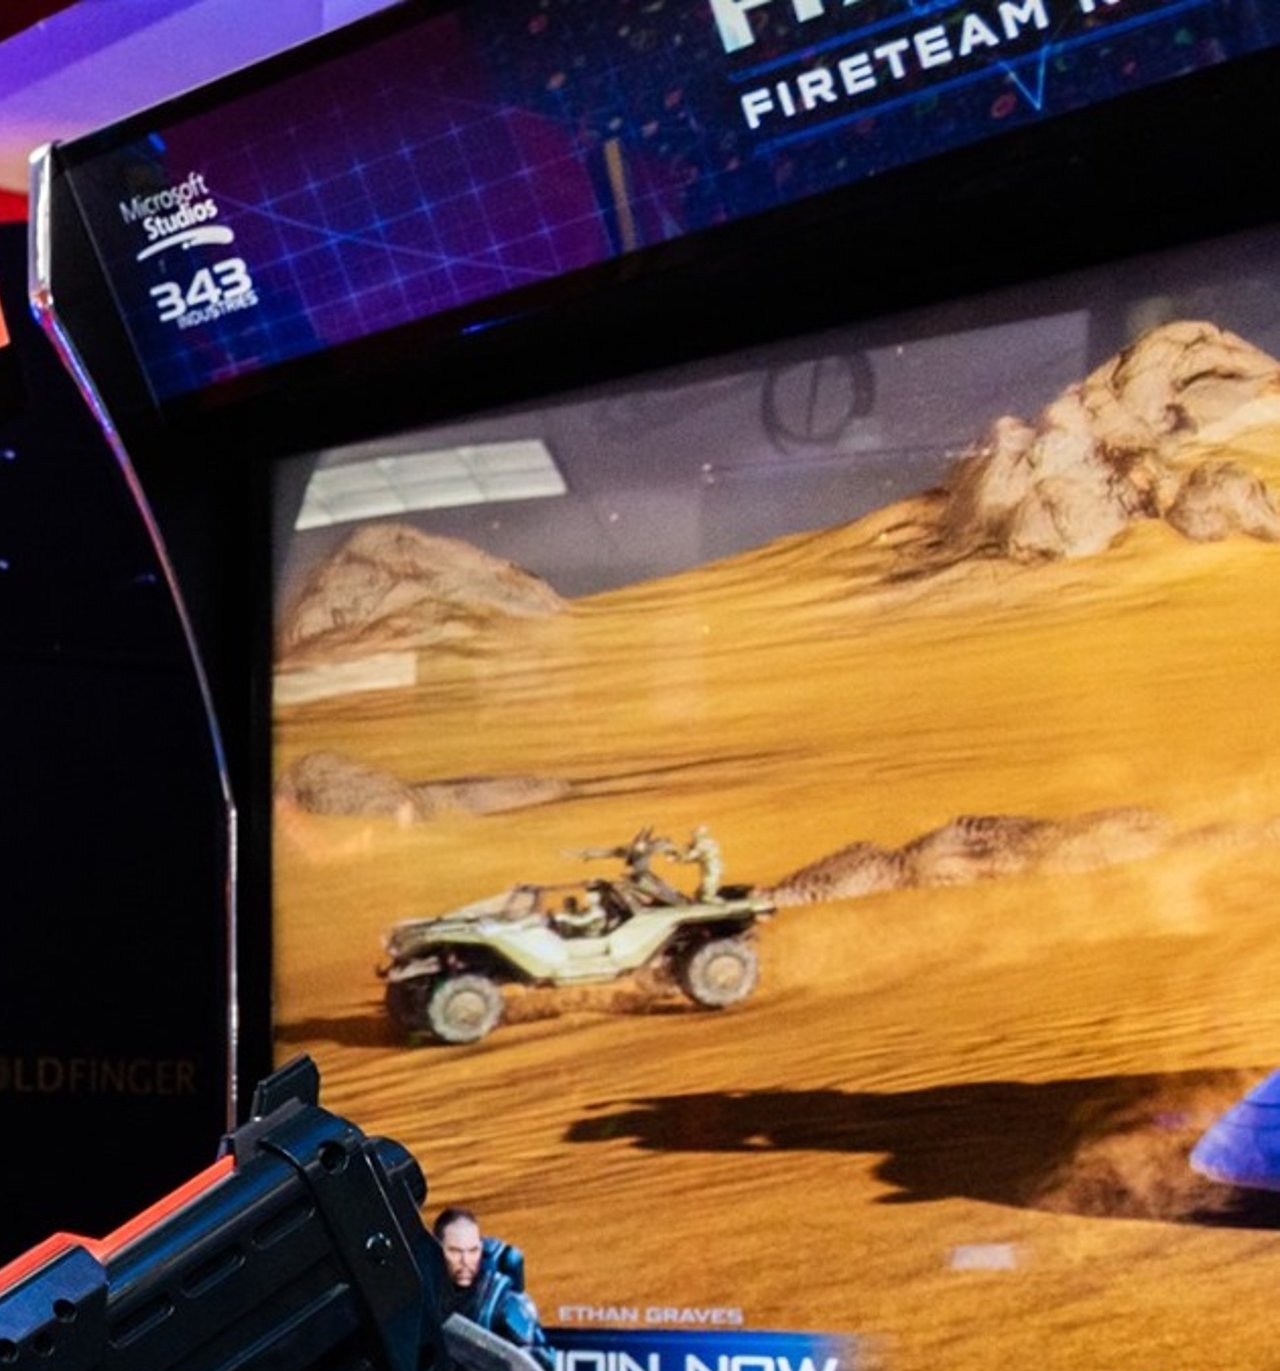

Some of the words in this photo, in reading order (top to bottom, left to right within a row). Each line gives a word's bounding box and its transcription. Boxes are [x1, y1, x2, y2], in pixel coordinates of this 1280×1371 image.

[741, 0, 1050, 128] FIRETEAM
[119, 171, 209, 224] Microsoft
[143, 198, 218, 241] Studios
[150, 257, 253, 322] 343
[558, 1305, 639, 1322] ETHAN
[645, 1306, 744, 1325] GRAVES
